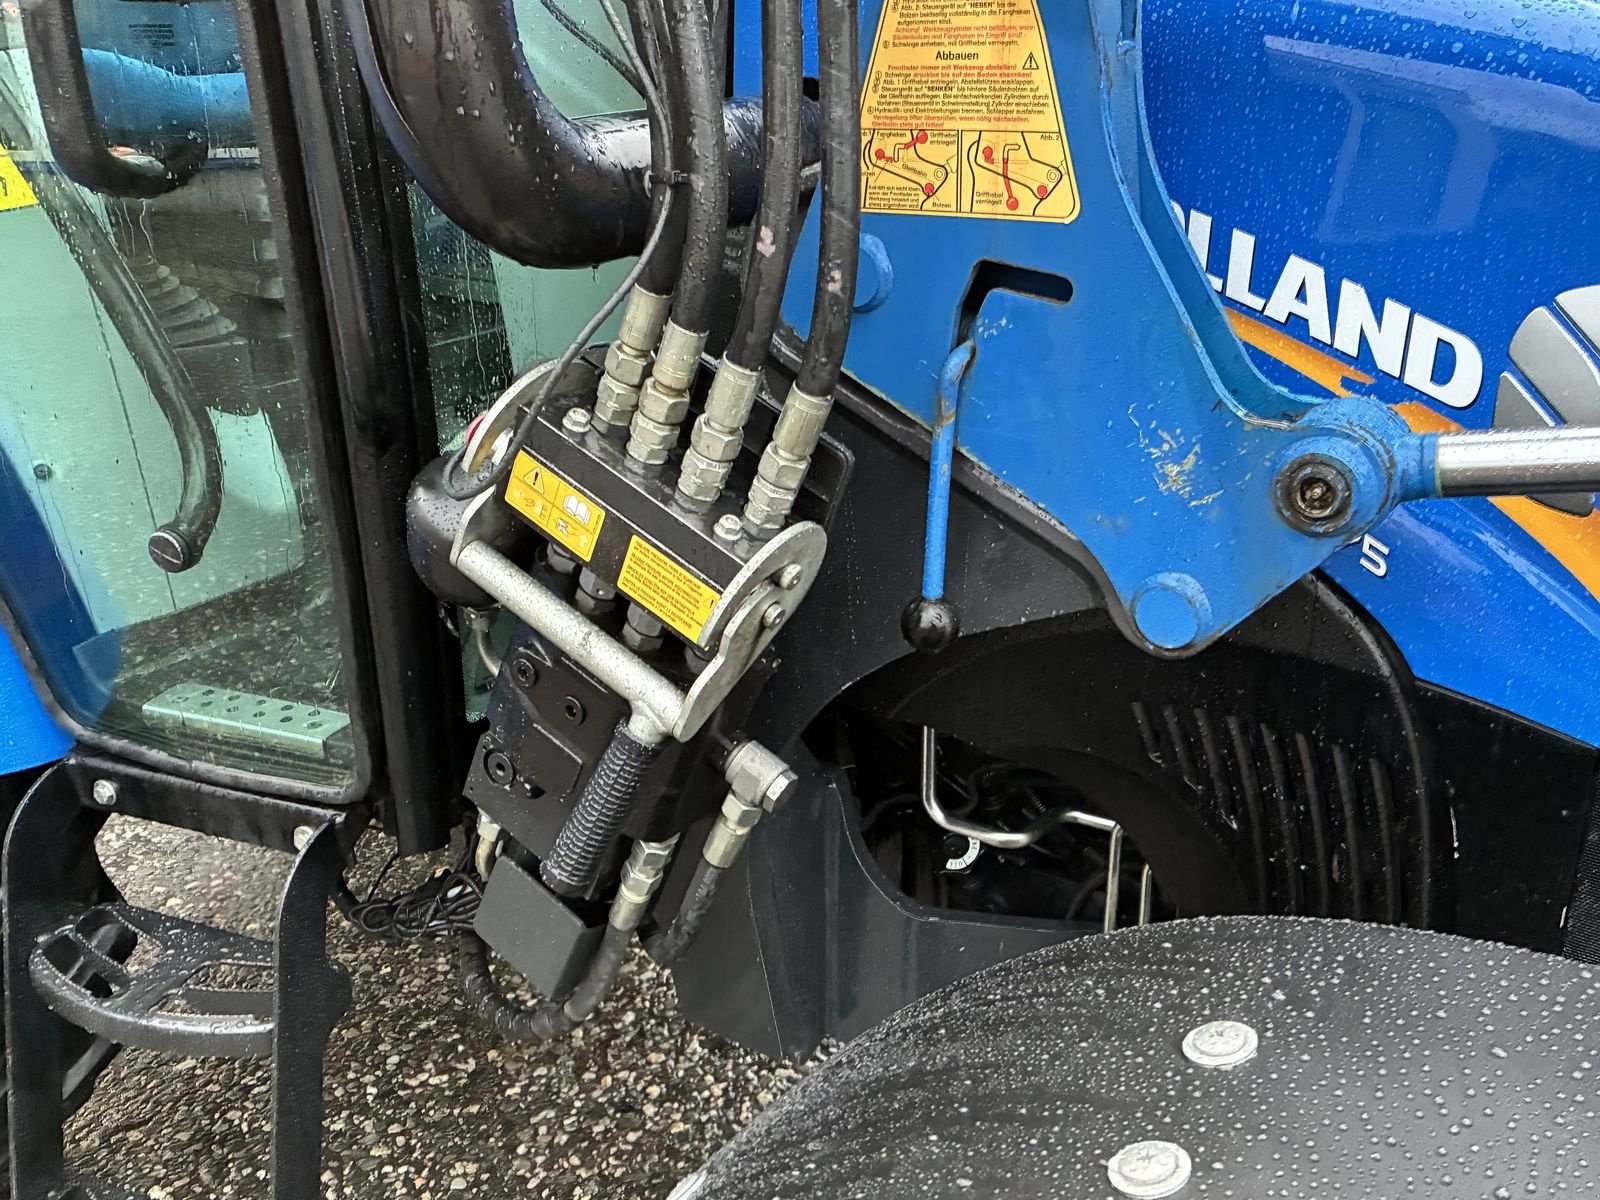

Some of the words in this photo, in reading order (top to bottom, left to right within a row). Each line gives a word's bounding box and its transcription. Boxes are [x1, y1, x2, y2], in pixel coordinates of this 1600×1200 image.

[922, 3, 955, 12] Steuergerät
[936, 51, 978, 60] Abbauen
[881, 86, 912, 94] Steuergerät
